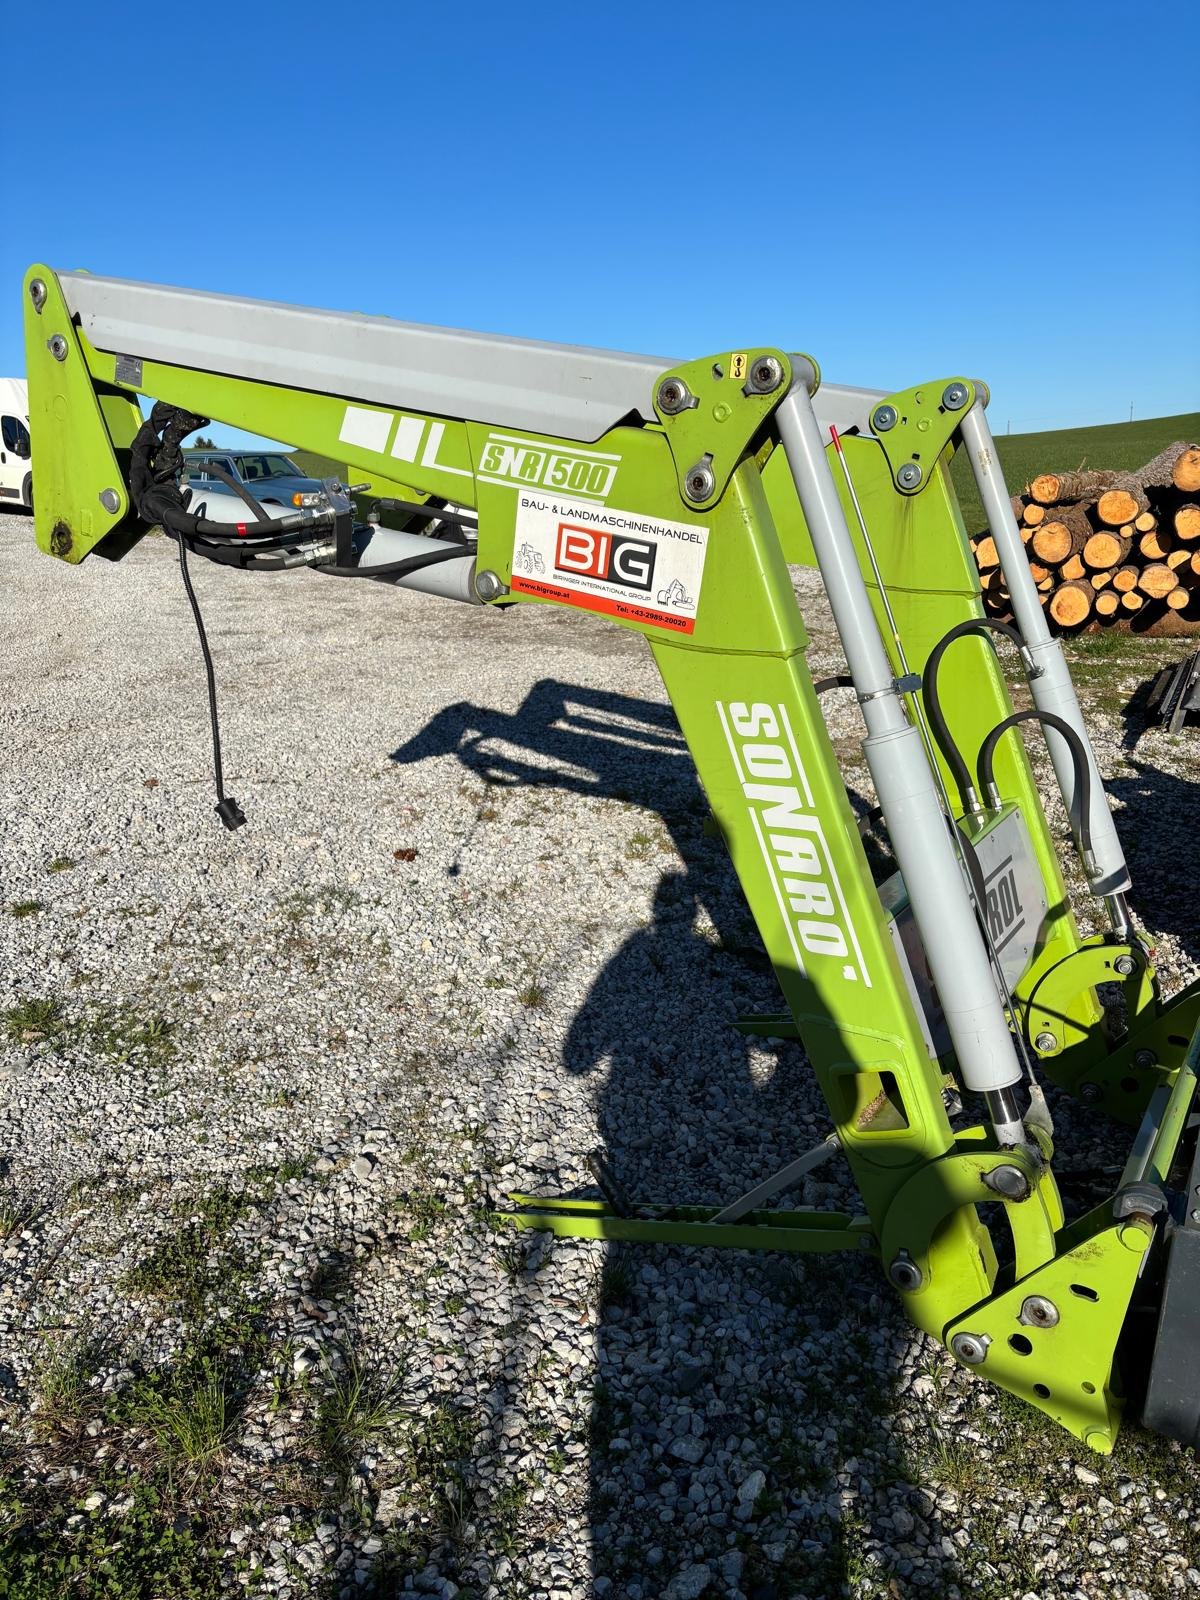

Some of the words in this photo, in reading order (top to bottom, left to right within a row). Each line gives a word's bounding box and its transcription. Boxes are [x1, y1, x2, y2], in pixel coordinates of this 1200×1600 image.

[483, 445, 541, 480] SNR
[551, 457, 610, 494] 500
[521, 499, 549, 511] BAU-
[560, 507, 702, 544] LANDMASCHINENHANDEL
[559, 527, 650, 585] BIG
[518, 581, 570, 598] www.bigroup.at
[553, 574, 580, 585] BIRINGER
[581, 582, 627, 597] INTERNATIONAL
[628, 592, 652, 601] GROUP
